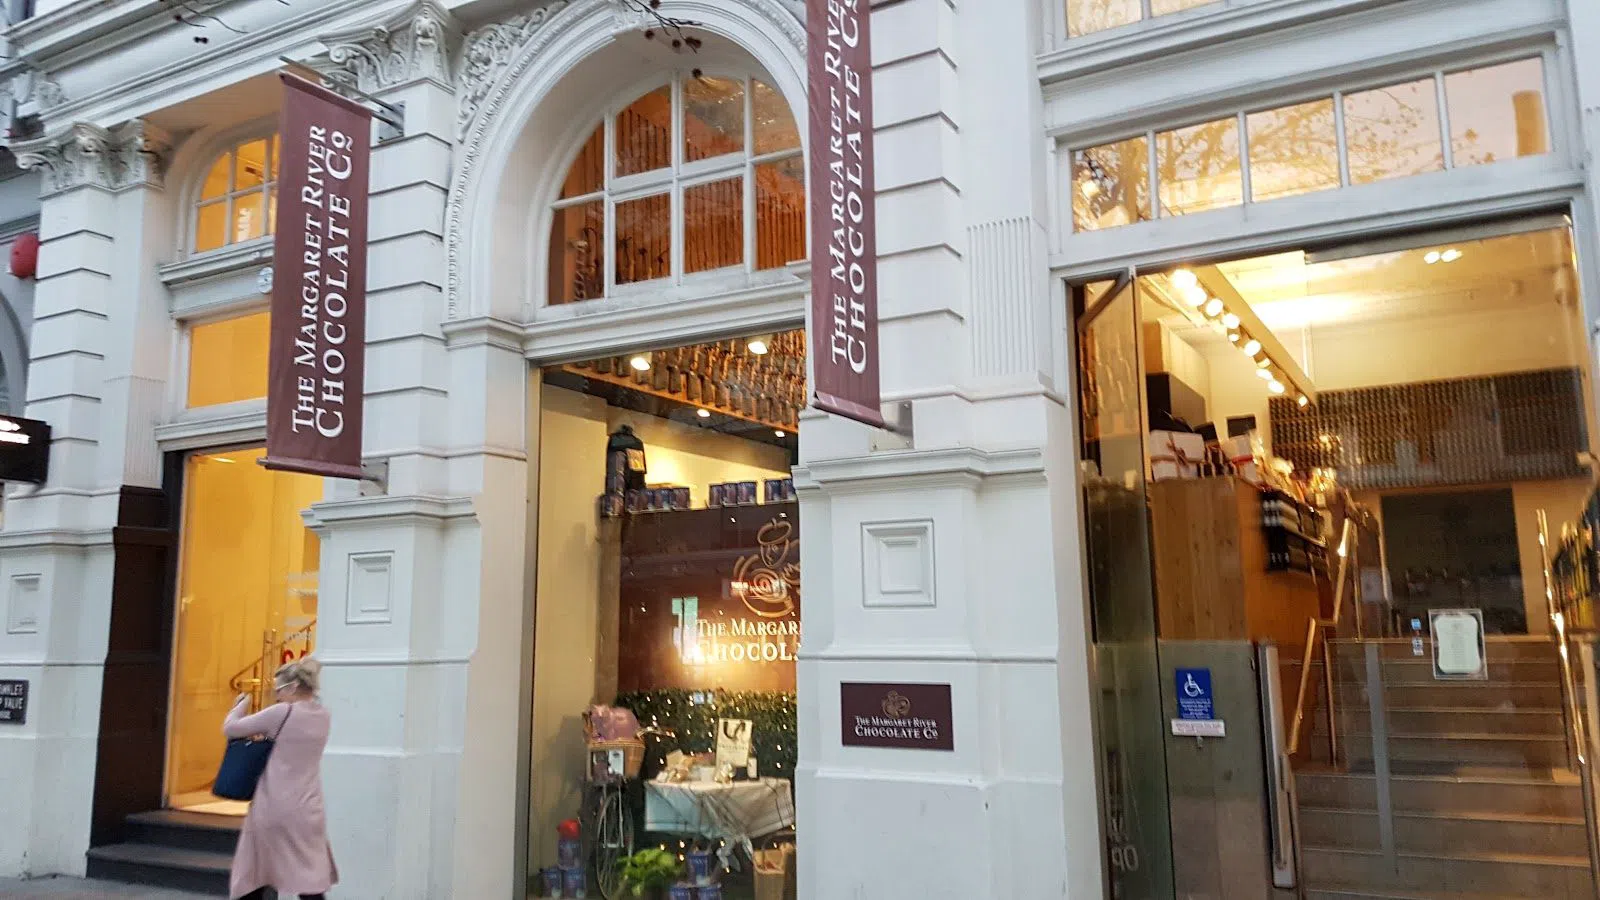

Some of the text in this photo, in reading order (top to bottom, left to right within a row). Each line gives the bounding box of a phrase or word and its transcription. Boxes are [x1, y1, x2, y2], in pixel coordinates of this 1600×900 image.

[291, 125, 326, 434] THE MARGARET RIVER
[824, 0, 848, 366] THE MARGARET RIVE
[845, 64, 867, 374] CHOCOLATE
[315, 193, 351, 439] CHOCOLATE
[697, 617, 802, 637] THE MARGAR
[854, 724, 921, 739] CHOCOLATE
[855, 715, 937, 730] THE MARGARET RIVER
